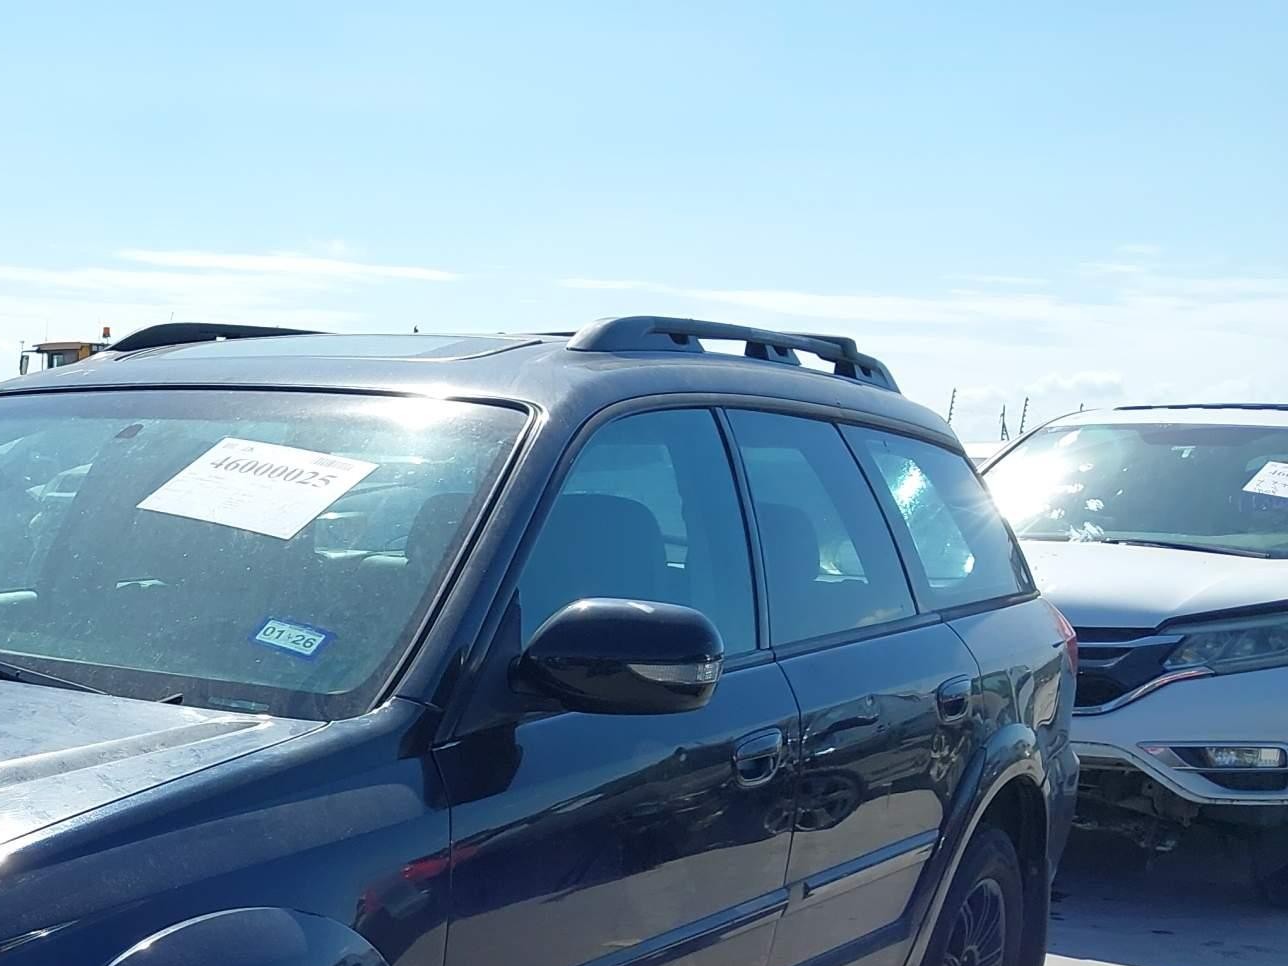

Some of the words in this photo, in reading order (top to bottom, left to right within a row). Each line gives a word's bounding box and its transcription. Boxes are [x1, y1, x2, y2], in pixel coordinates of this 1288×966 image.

[210, 456, 339, 488] 46000025
[262, 626, 286, 640] 01
[291, 634, 316, 649] 26
